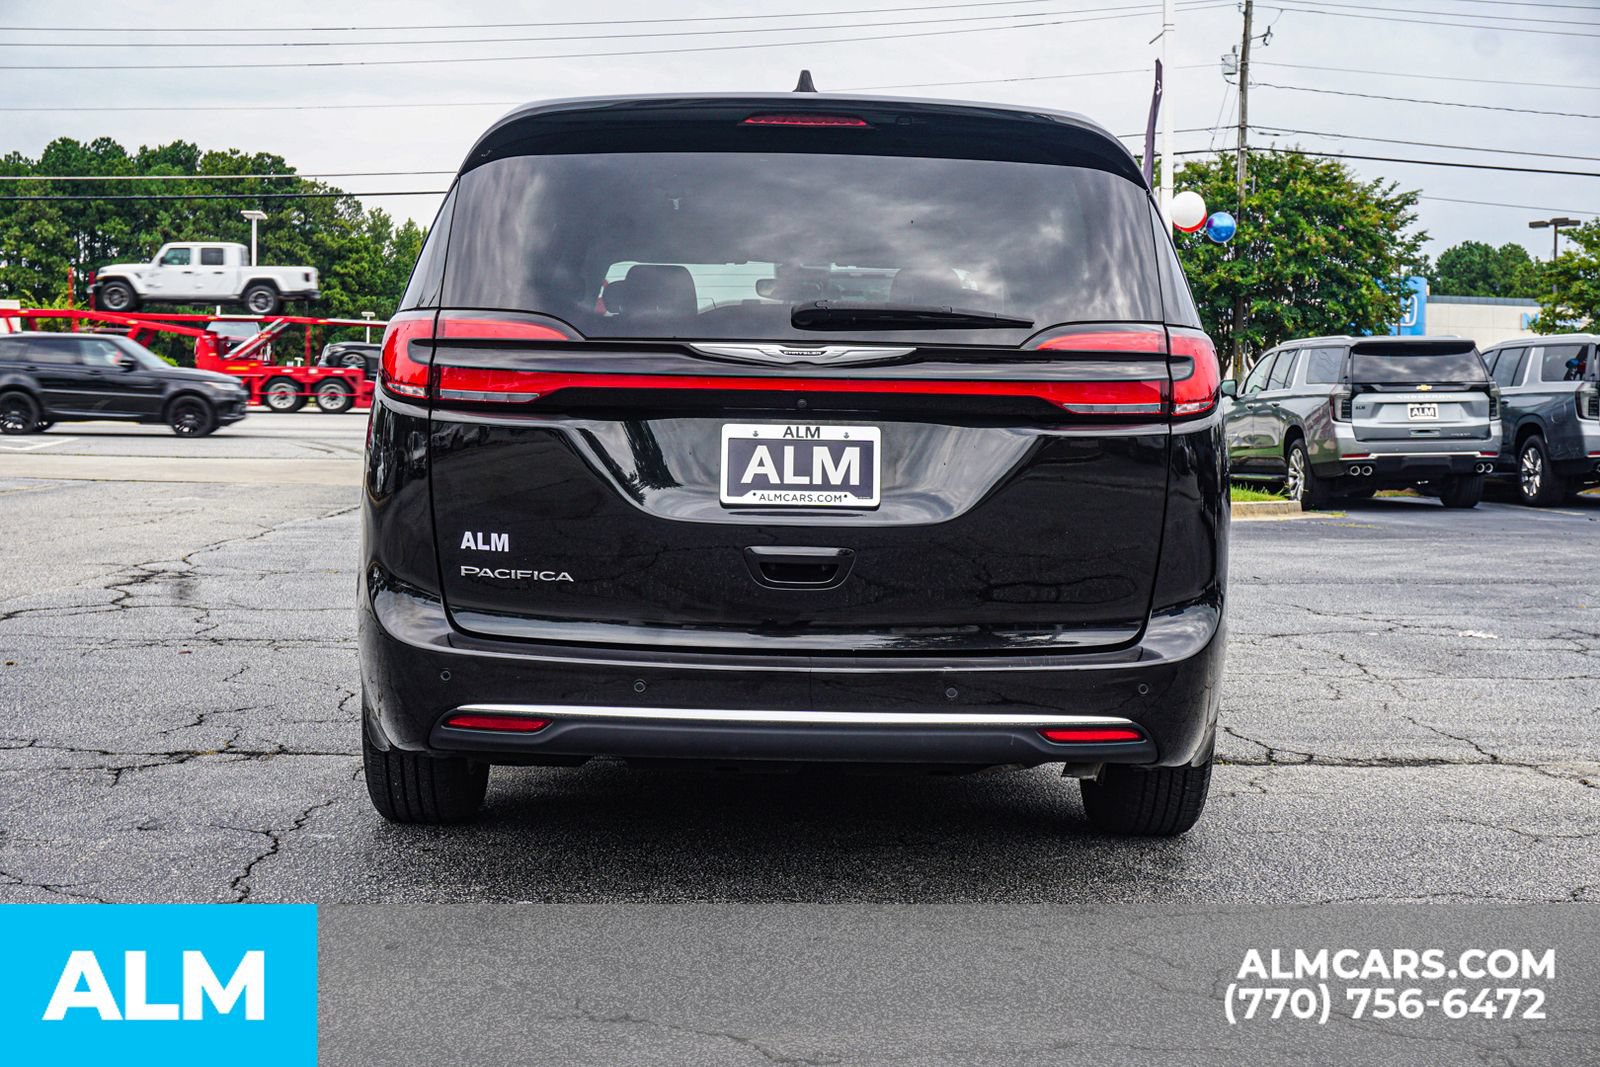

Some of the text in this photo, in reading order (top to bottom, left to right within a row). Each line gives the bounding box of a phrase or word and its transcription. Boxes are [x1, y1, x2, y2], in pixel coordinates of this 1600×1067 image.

[1412, 408, 1435, 417] ALM
[783, 426, 821, 439] ALM
[740, 445, 861, 486] ALM
[758, 493, 842, 503] ALMCARS.COM
[460, 531, 509, 552] ALM
[460, 565, 574, 582] PACIFICA
